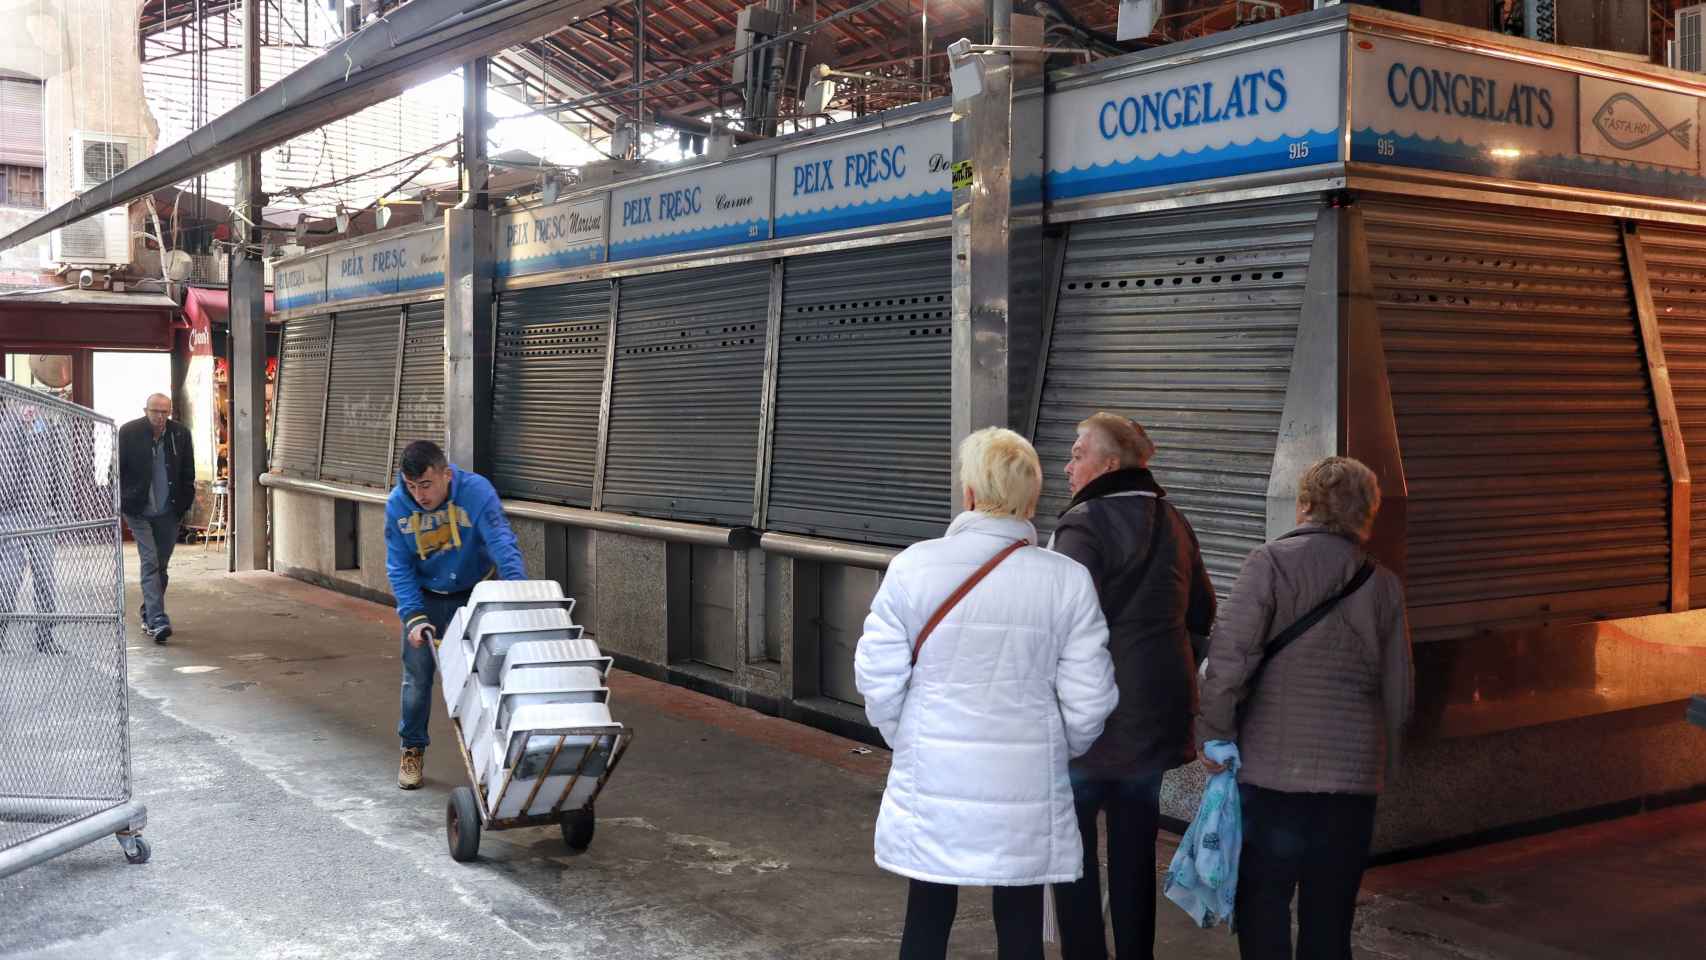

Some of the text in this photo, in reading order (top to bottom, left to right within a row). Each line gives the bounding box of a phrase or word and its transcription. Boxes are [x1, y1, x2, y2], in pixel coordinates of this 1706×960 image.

[1099, 68, 1287, 140] CONGELATS
[1387, 62, 1554, 129] CONGELATS
[1289, 141, 1309, 160] 915
[1377, 139, 1394, 156] 915
[792, 159, 834, 196] PEIX
[844, 145, 906, 188] FRESC
[623, 196, 652, 226] PEIX
[658, 186, 702, 221] FRESC
[506, 222, 529, 248] PEIX
[534, 213, 566, 243] FRESC
[341, 255, 364, 277] PEIX
[372, 248, 406, 273] FRESC
